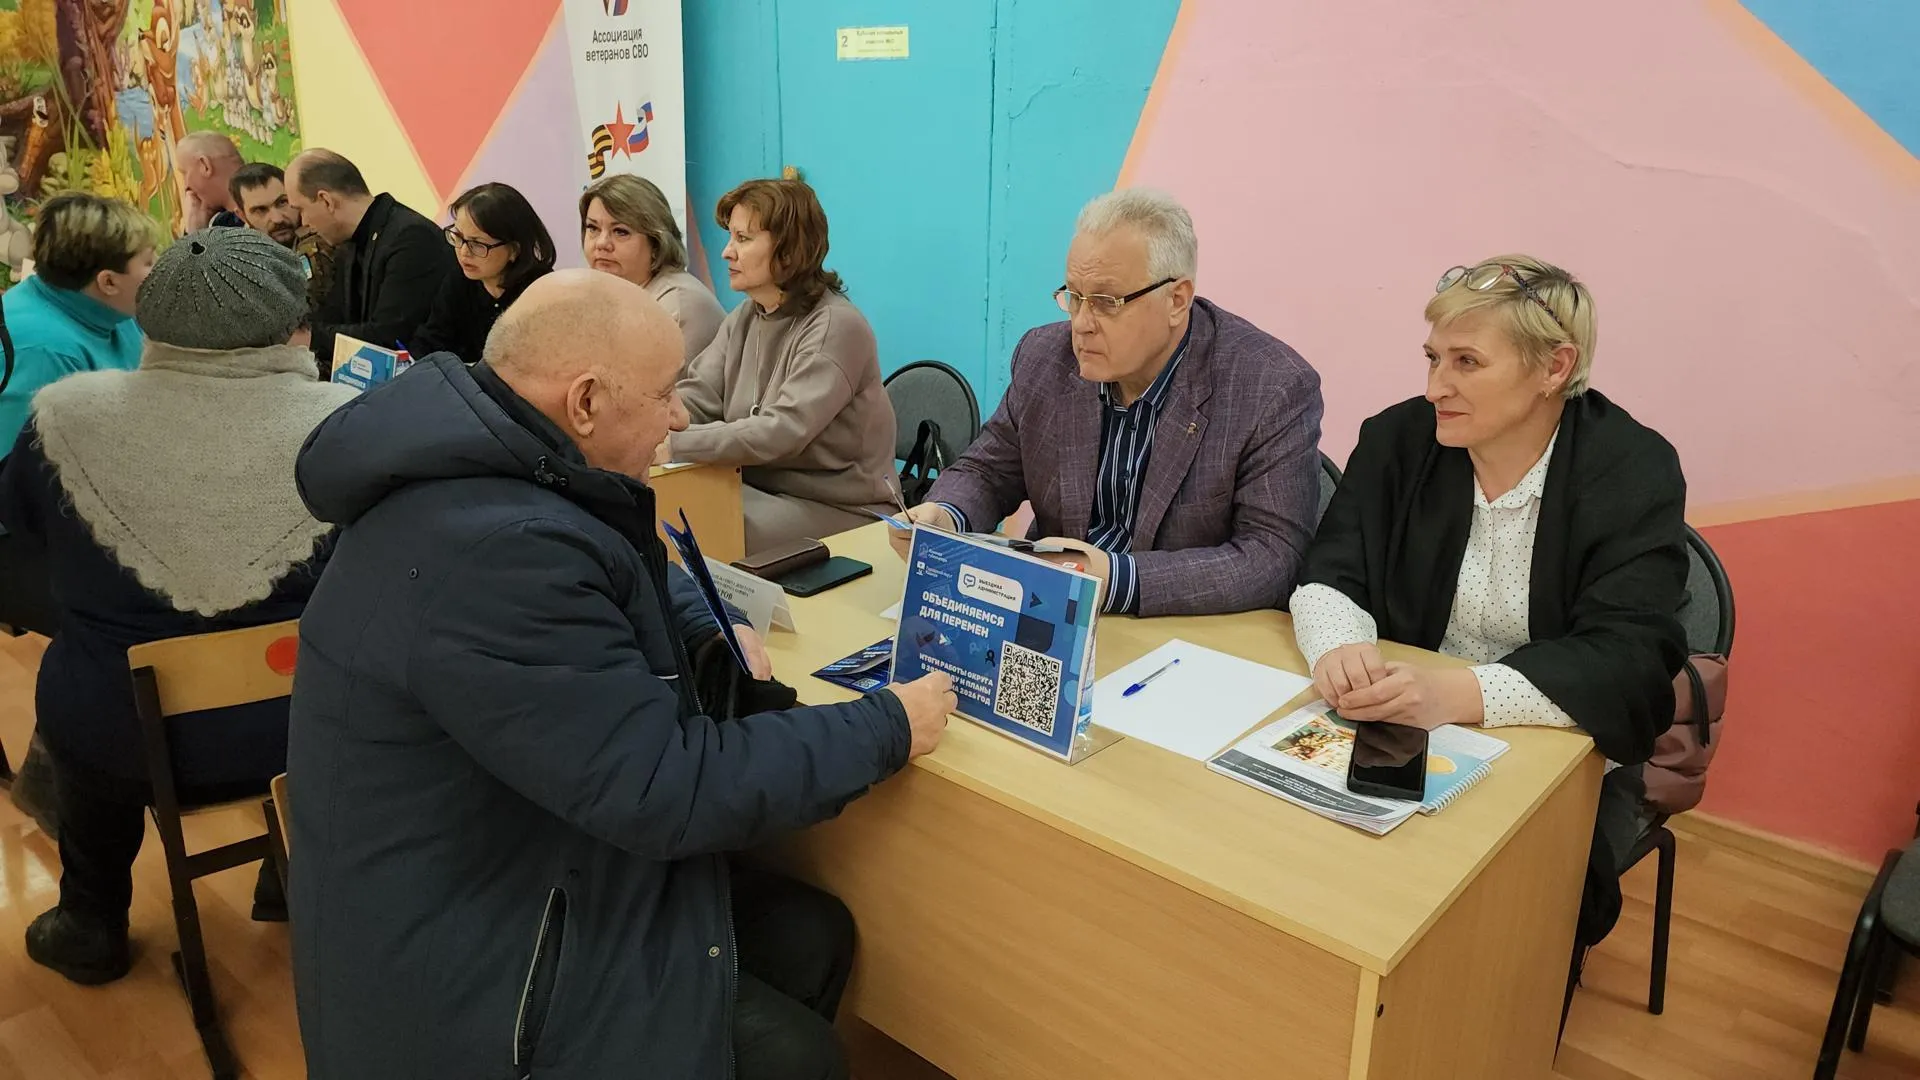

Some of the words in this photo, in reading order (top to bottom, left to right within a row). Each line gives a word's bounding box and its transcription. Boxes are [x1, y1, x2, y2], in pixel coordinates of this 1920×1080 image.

[592, 28, 642, 43] Ассоциация
[841, 35, 848, 47] 2
[586, 48, 630, 63] ветеранов
[632, 43, 649, 59] СВО
[919, 605, 941, 621] ДЛЯ
[942, 612, 989, 638] ПЕРЕМЕН
[922, 590, 1005, 628] ОБЪЕДИНЯЕМСЯ
[919, 652, 940, 666] ИТОГИ
[940, 661, 967, 677] РАБОТЫ
[967, 671, 993, 686] ОКРУГА
[921, 662, 926, 670] В
[965, 679, 991, 695] ПЛАНЫ
[960, 687, 976, 699] 2026
[976, 695, 991, 706] ГОД
